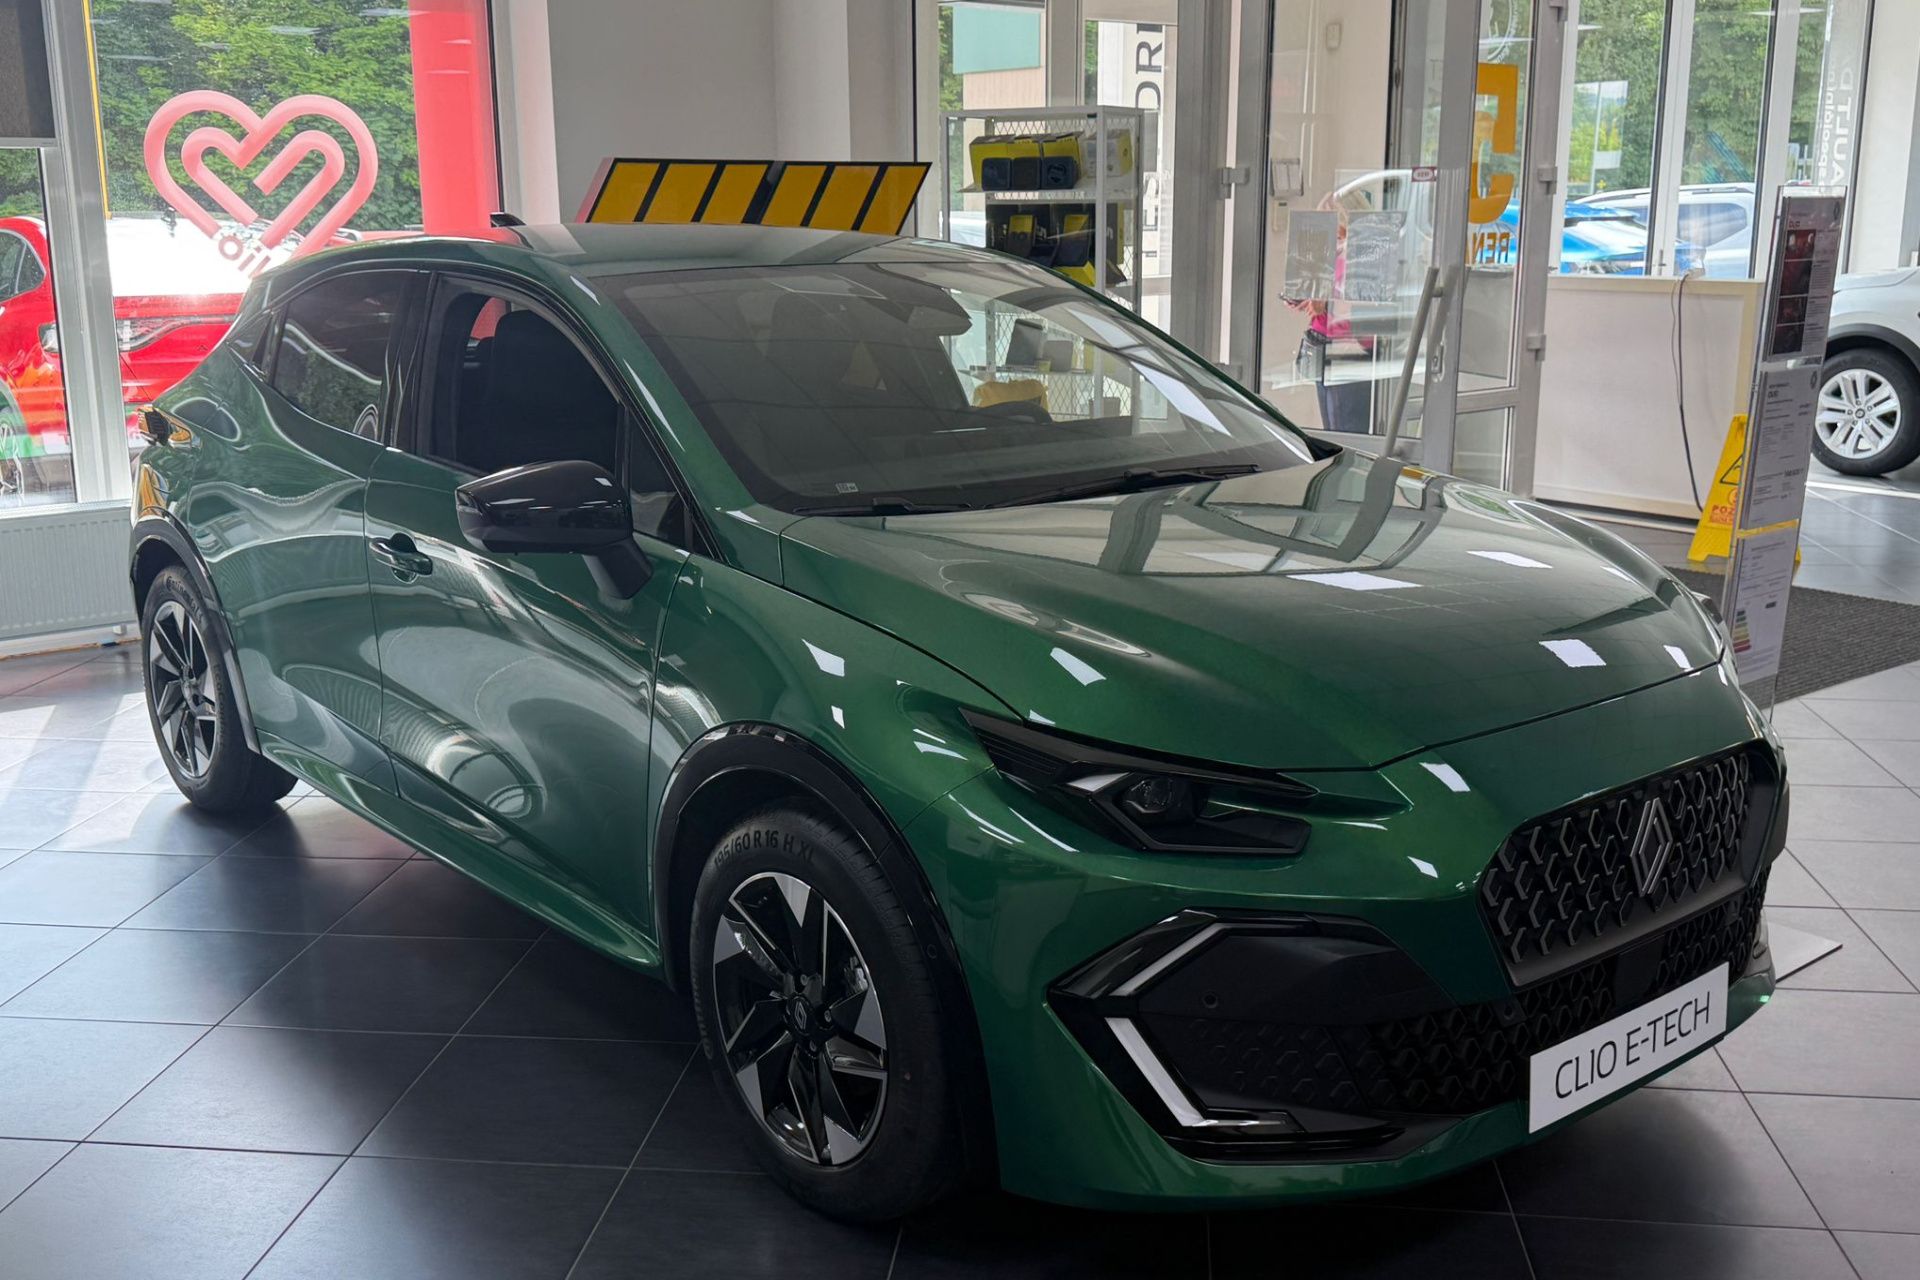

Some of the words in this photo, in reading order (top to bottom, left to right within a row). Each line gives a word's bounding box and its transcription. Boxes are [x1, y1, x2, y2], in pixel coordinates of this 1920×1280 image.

[753, 830, 762, 849] R
[765, 829, 779, 849] 16
[783, 833, 795, 852] H
[1555, 1040, 1618, 1099] CLIO
[1626, 991, 1711, 1067] E-TECH
